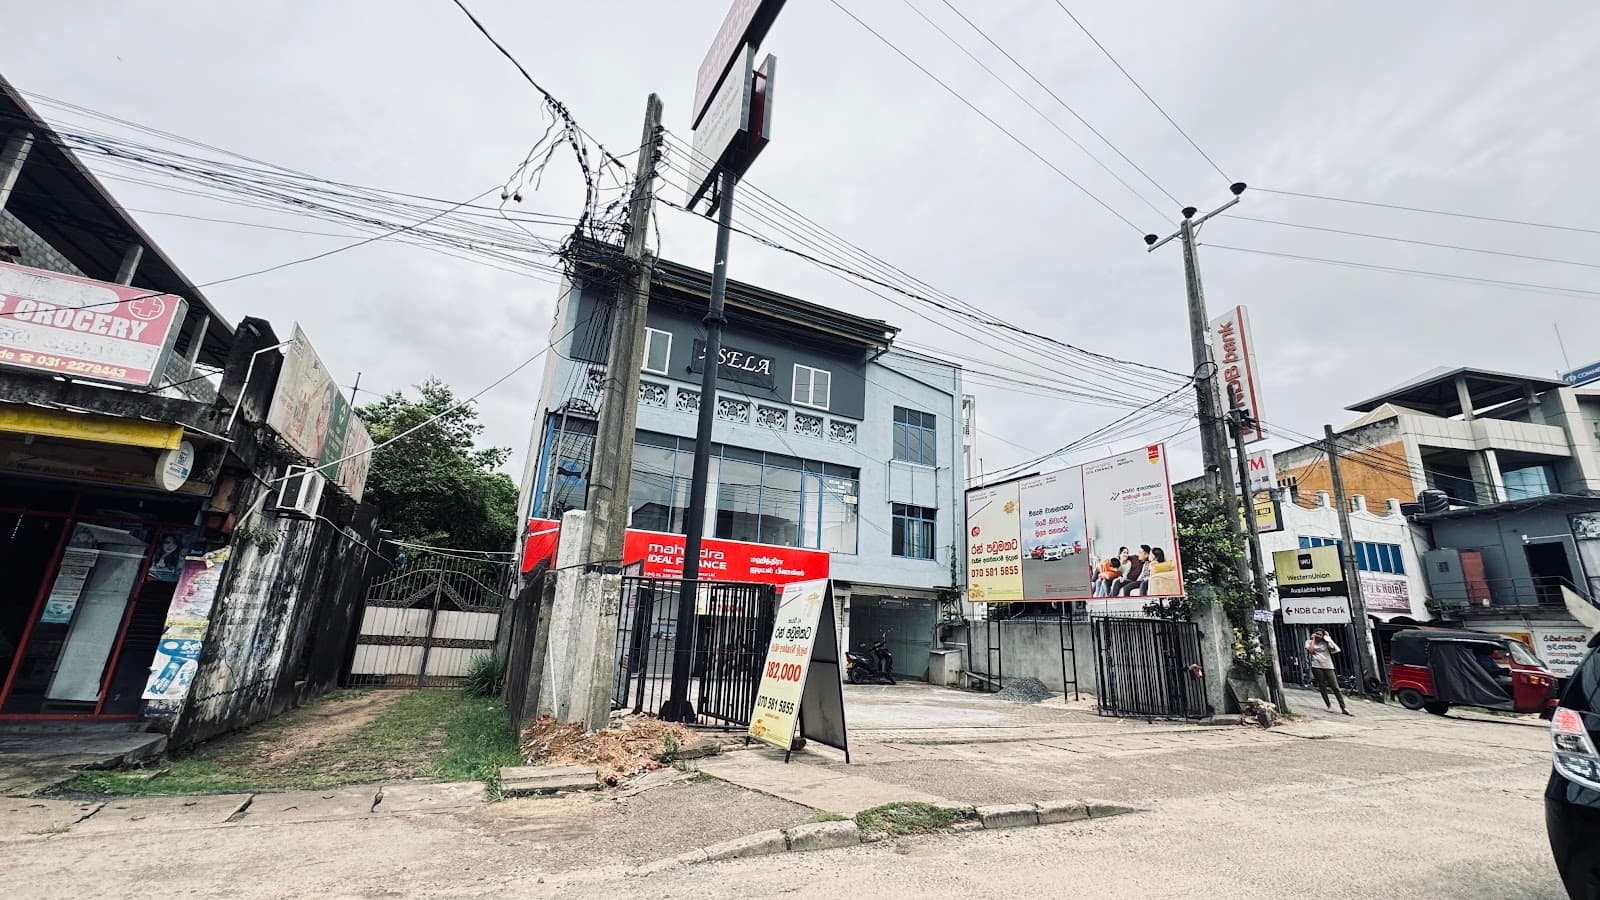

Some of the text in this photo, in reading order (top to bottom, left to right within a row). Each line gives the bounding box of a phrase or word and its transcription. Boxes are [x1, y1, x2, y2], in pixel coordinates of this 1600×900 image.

[1218, 321, 1240, 364] bank
[648, 543, 725, 560] mahdra
[647, 554, 728, 570] IDEAL FNCE
[971, 565, 1019, 578] 070 581 5855
[1290, 586, 1317, 594] Available
[1382, 583, 1402, 595] Hotel
[1326, 606, 1345, 614] Park
[765, 661, 802, 682] 182,000
[757, 695, 795, 715] 070 581 5855
